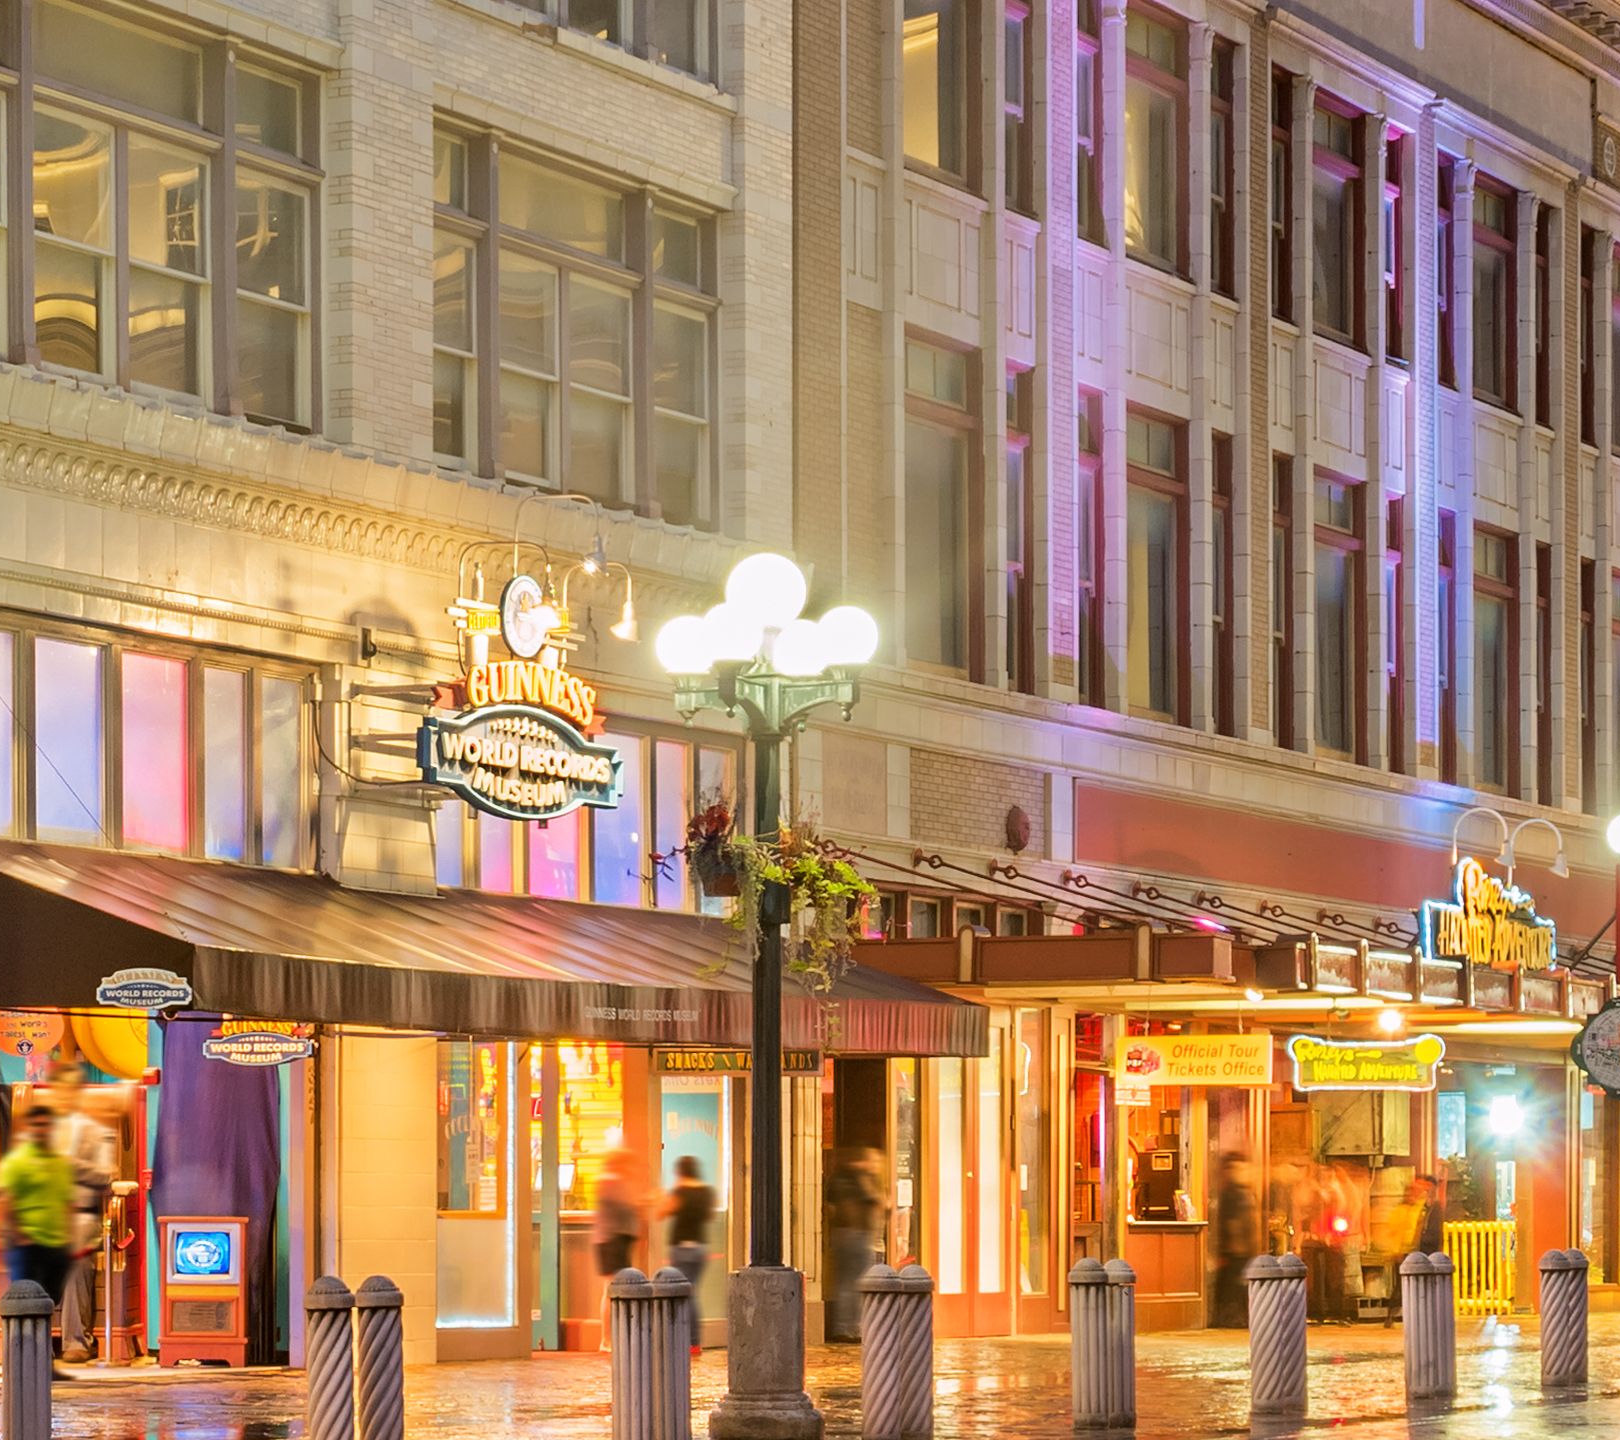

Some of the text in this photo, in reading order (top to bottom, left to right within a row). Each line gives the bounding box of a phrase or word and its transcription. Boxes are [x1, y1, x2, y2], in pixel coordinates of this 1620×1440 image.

[468, 662, 597, 726] GUINNESS
[442, 732, 610, 783] WORLD RECORDS
[473, 768, 566, 807] MUSEUM
[121, 998, 163, 1006] MUSEUM
[586, 1007, 616, 1020] GUINNESS
[619, 1009, 640, 1020] WORLD
[643, 1010, 672, 1021] RECORDS
[221, 1022, 294, 1034] GUINNESS
[211, 1043, 305, 1052] WORLD RECORDS
[1173, 1044, 1260, 1058] Official Tour
[231, 1053, 282, 1063] MUSEUM
[666, 1053, 714, 1070] SNACKS
[736, 1054, 752, 1070] WA
[781, 1054, 814, 1069] ANDS
[1167, 1062, 1265, 1076] Tickets Office
[1359, 1064, 1418, 1080] ADVENTURE
